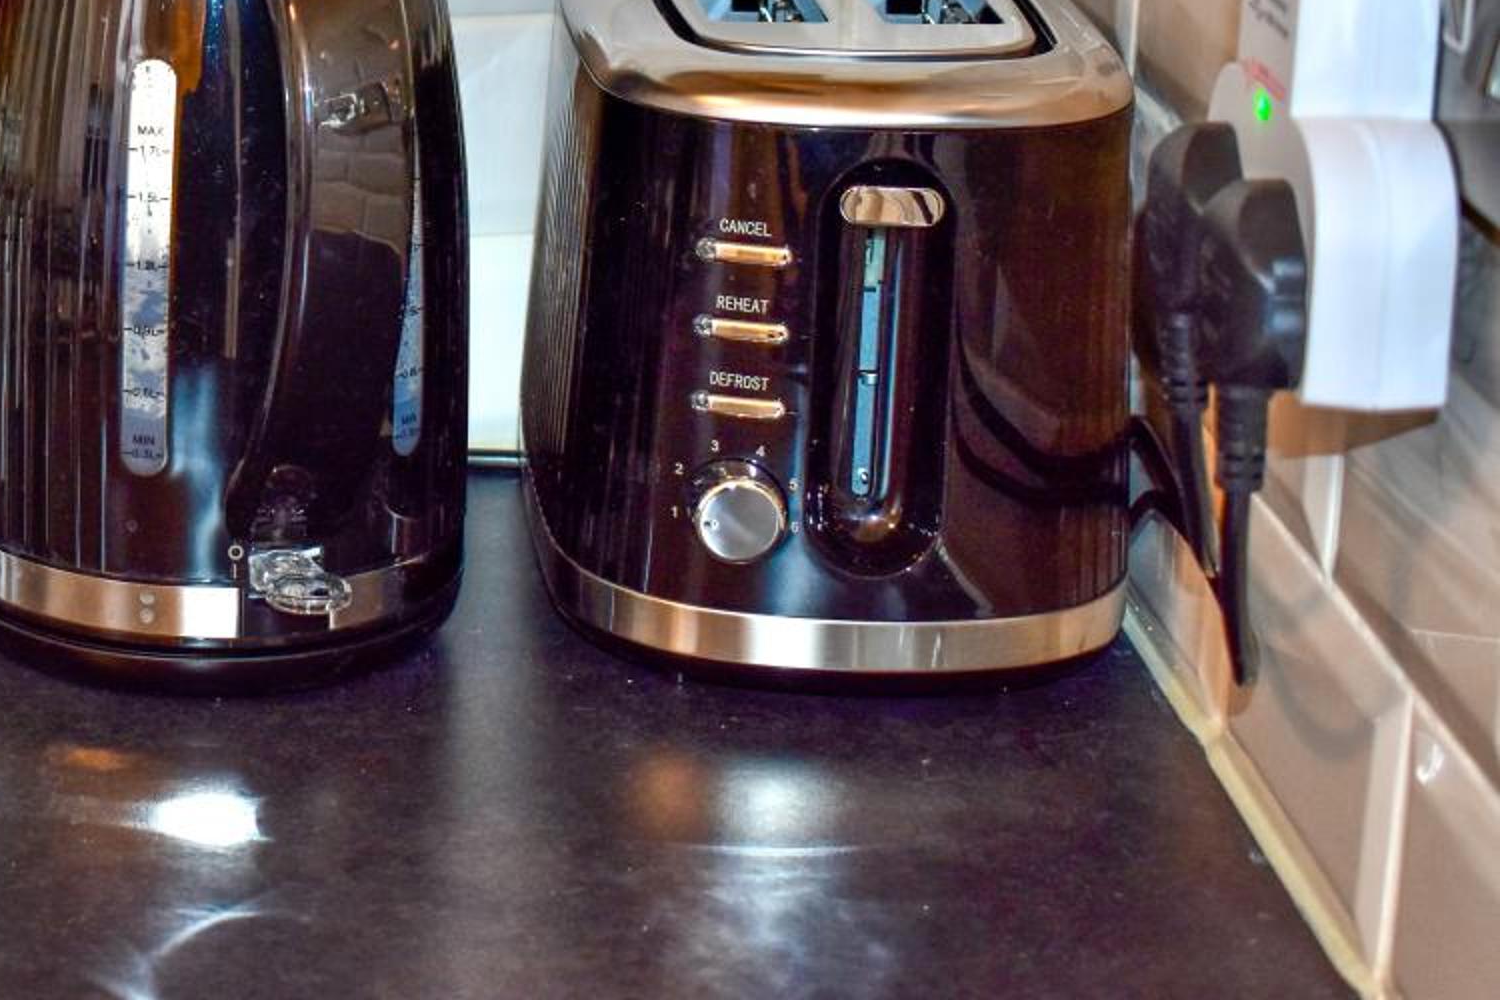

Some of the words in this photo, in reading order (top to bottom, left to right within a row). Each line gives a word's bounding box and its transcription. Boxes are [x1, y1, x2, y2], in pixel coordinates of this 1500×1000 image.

[718, 217, 773, 237] CANCEL
[715, 295, 770, 314] REHEAT
[709, 371, 771, 391] DEFROST
[710, 439, 720, 453] 3
[755, 445, 765, 457] 4
[675, 461, 684, 476] 2
[671, 505, 678, 519] 1
